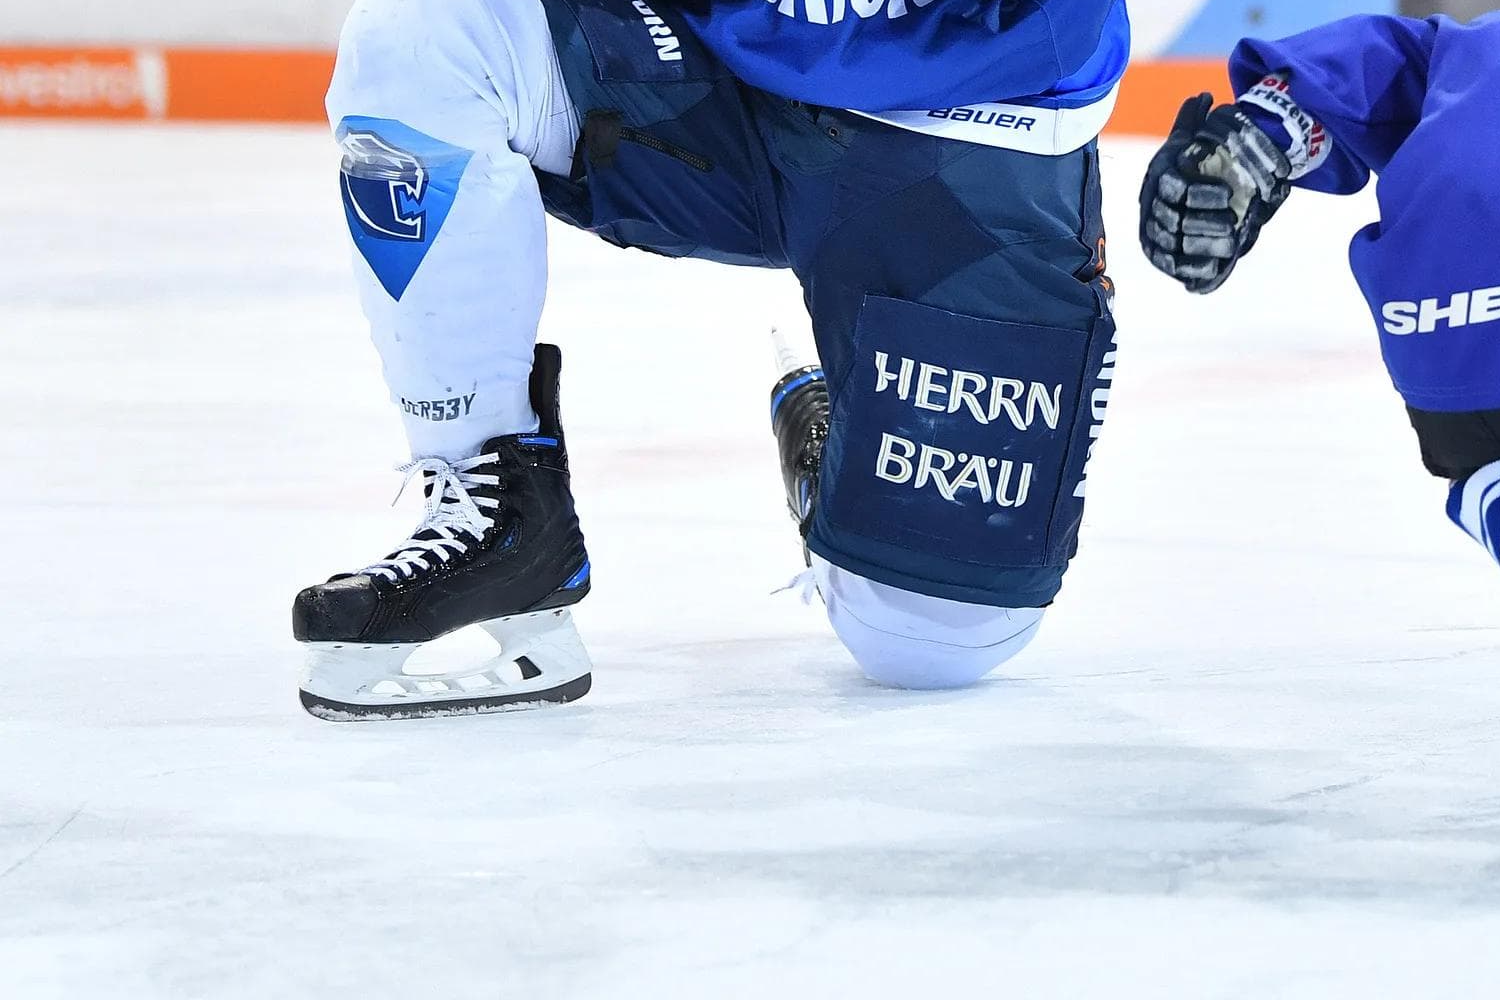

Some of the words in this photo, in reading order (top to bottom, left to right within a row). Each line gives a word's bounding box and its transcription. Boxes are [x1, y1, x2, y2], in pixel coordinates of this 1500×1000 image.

[926, 108, 1037, 132] BAUER
[875, 350, 1062, 431] HERRN
[875, 432, 1033, 508] BRÄU
